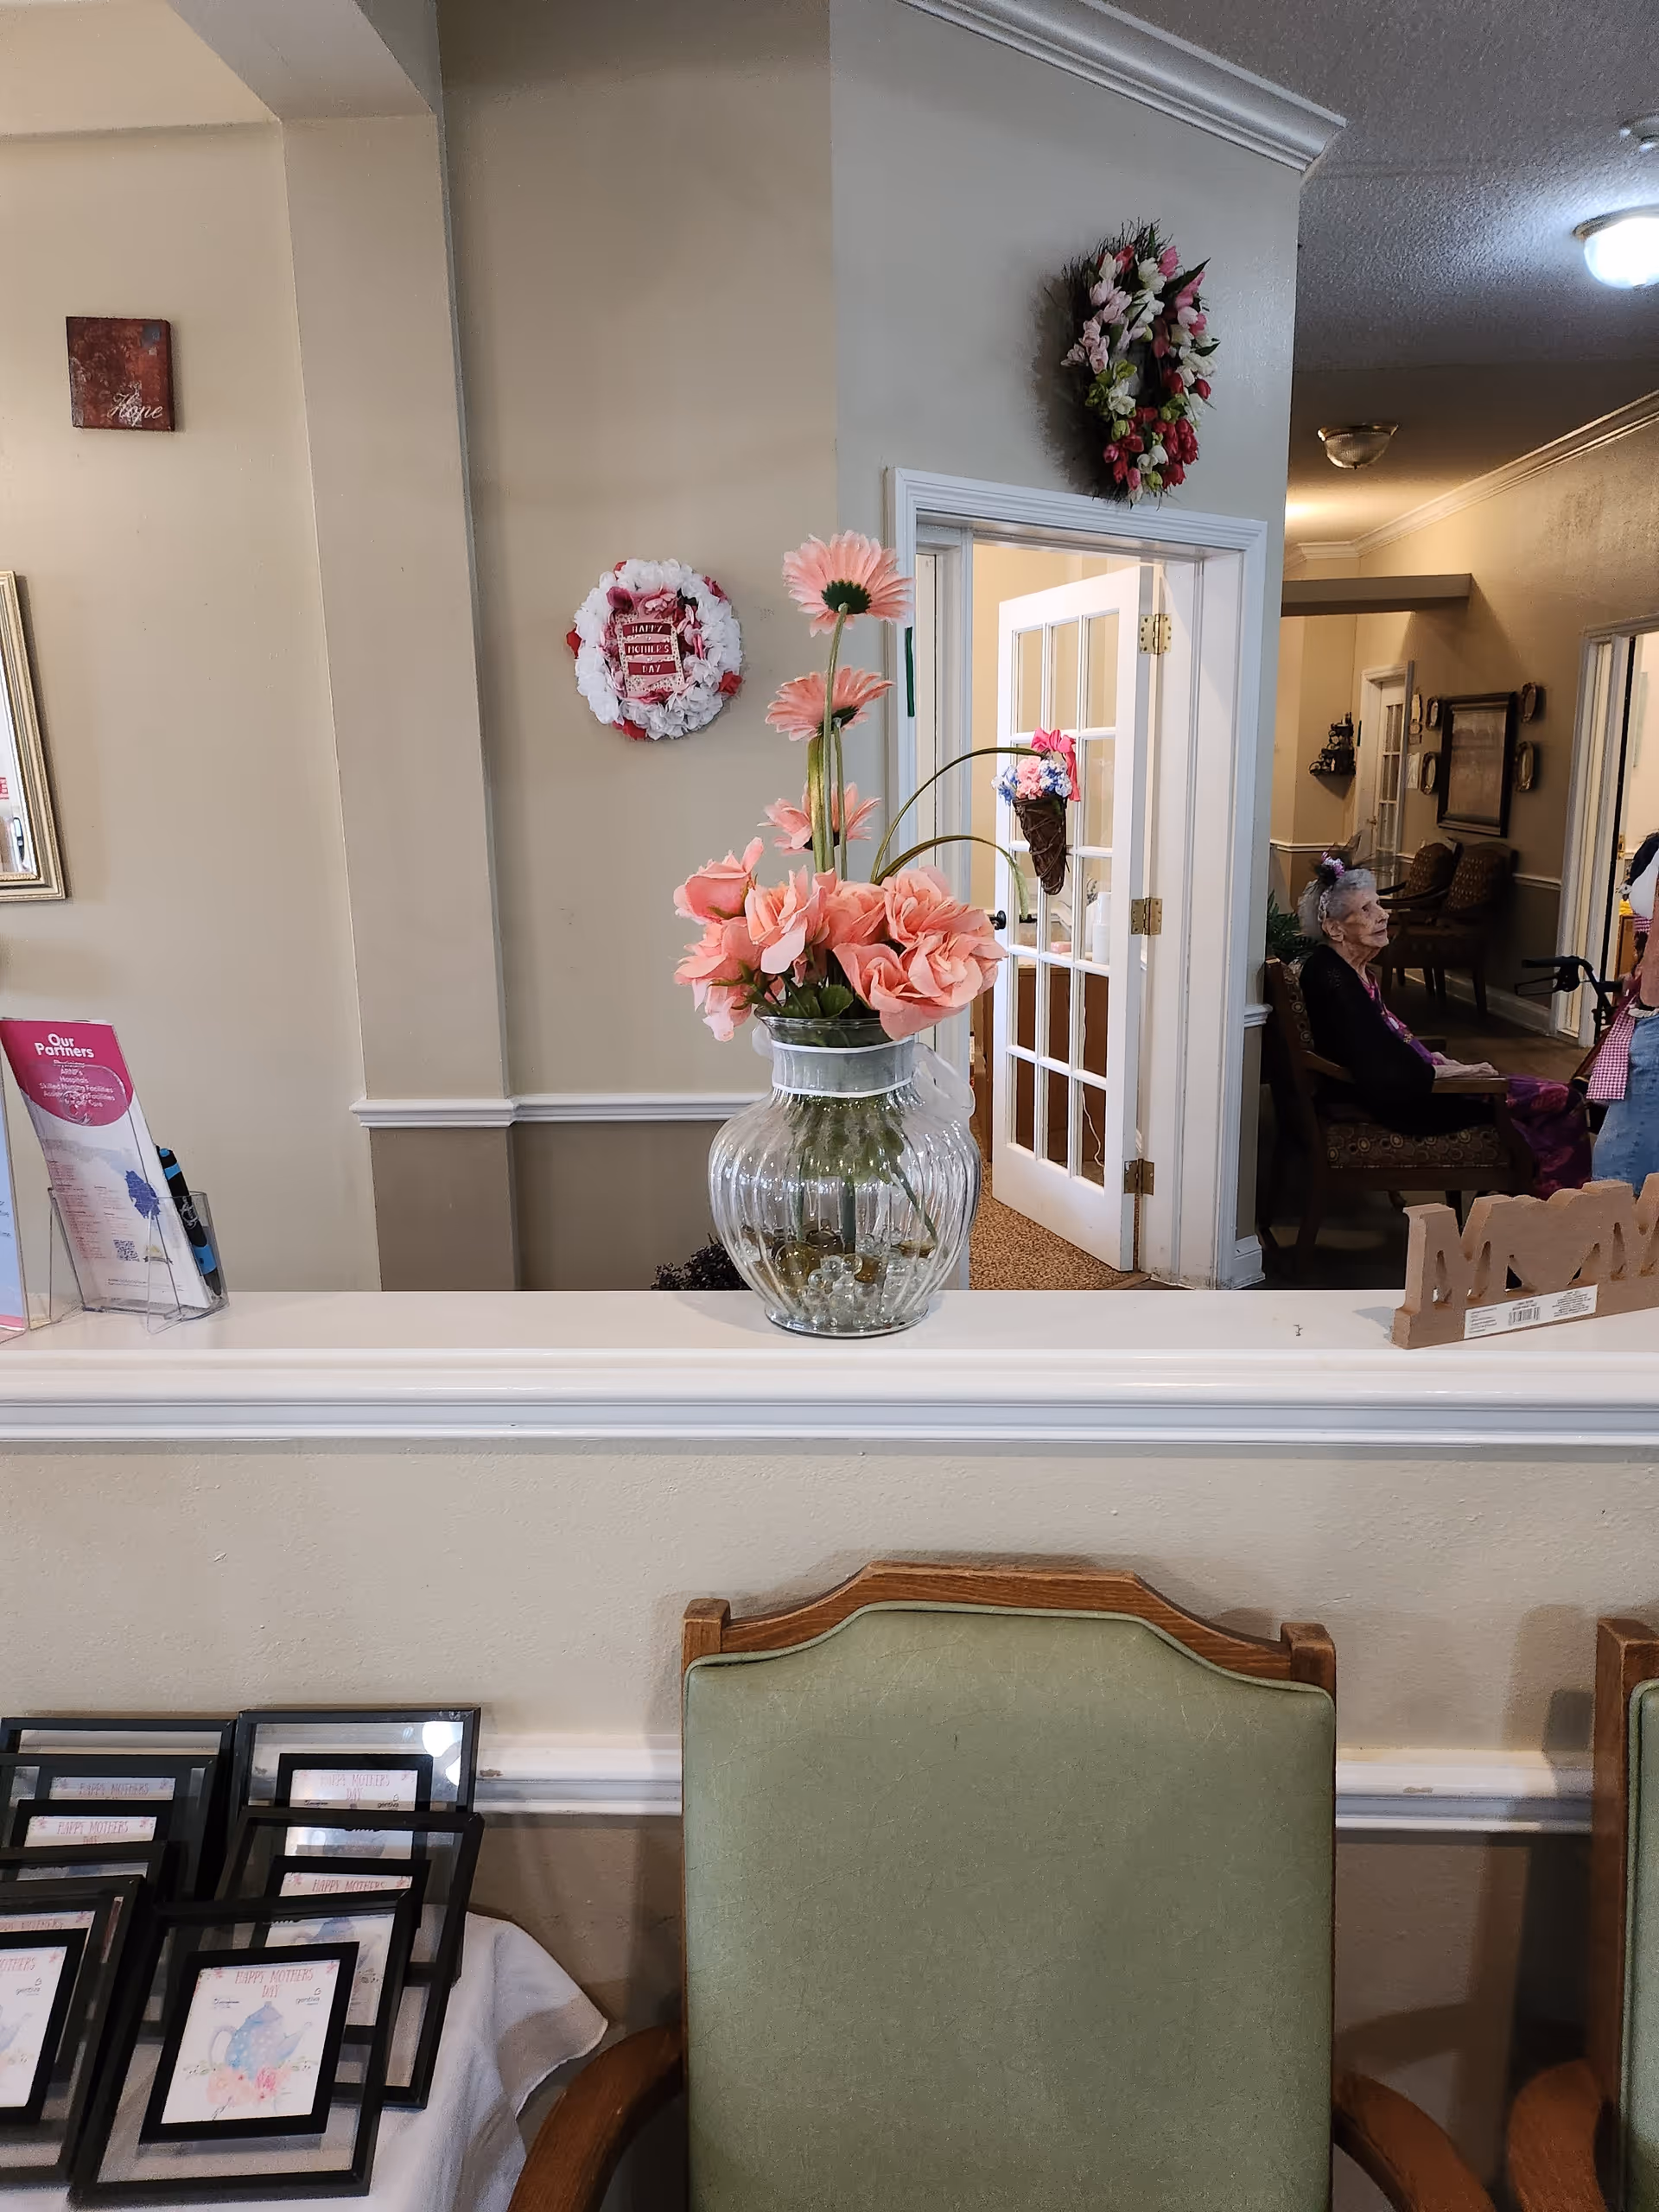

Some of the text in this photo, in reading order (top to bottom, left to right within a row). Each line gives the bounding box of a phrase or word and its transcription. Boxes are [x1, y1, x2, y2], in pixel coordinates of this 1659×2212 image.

[632, 625, 662, 633] HAPPY
[627, 644, 670, 654] MOTHER'S
[642, 664, 661, 673] DAY
[48, 1033, 74, 1047] Our
[35, 1042, 94, 1058] Partners
[312, 1878, 340, 1892] HAPPY
[234, 1967, 314, 1984] HAPPY MOTHERS
[262, 1985, 280, 1998] DAY
